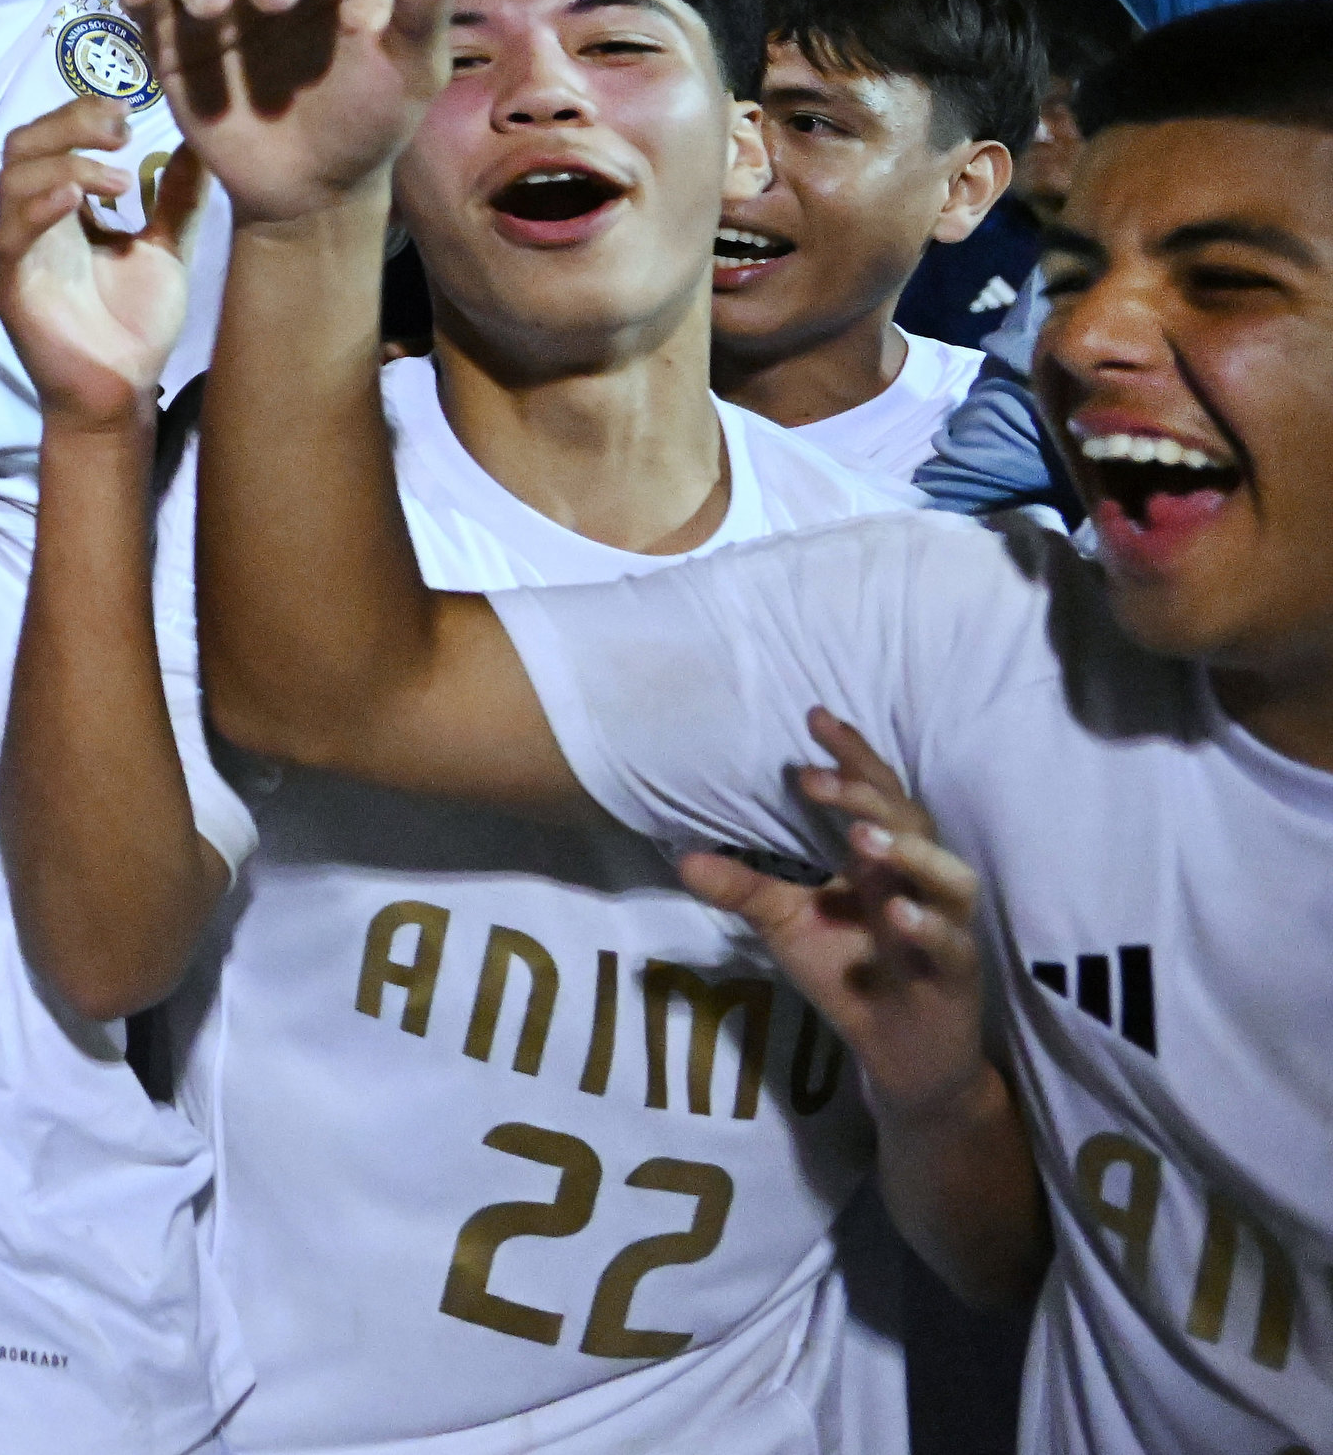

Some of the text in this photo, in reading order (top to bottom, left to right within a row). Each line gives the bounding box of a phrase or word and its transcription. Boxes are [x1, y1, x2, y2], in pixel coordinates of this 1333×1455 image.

[65, 20, 128, 48] ANIMO SOCCER
[439, 1121, 735, 1360] 22
